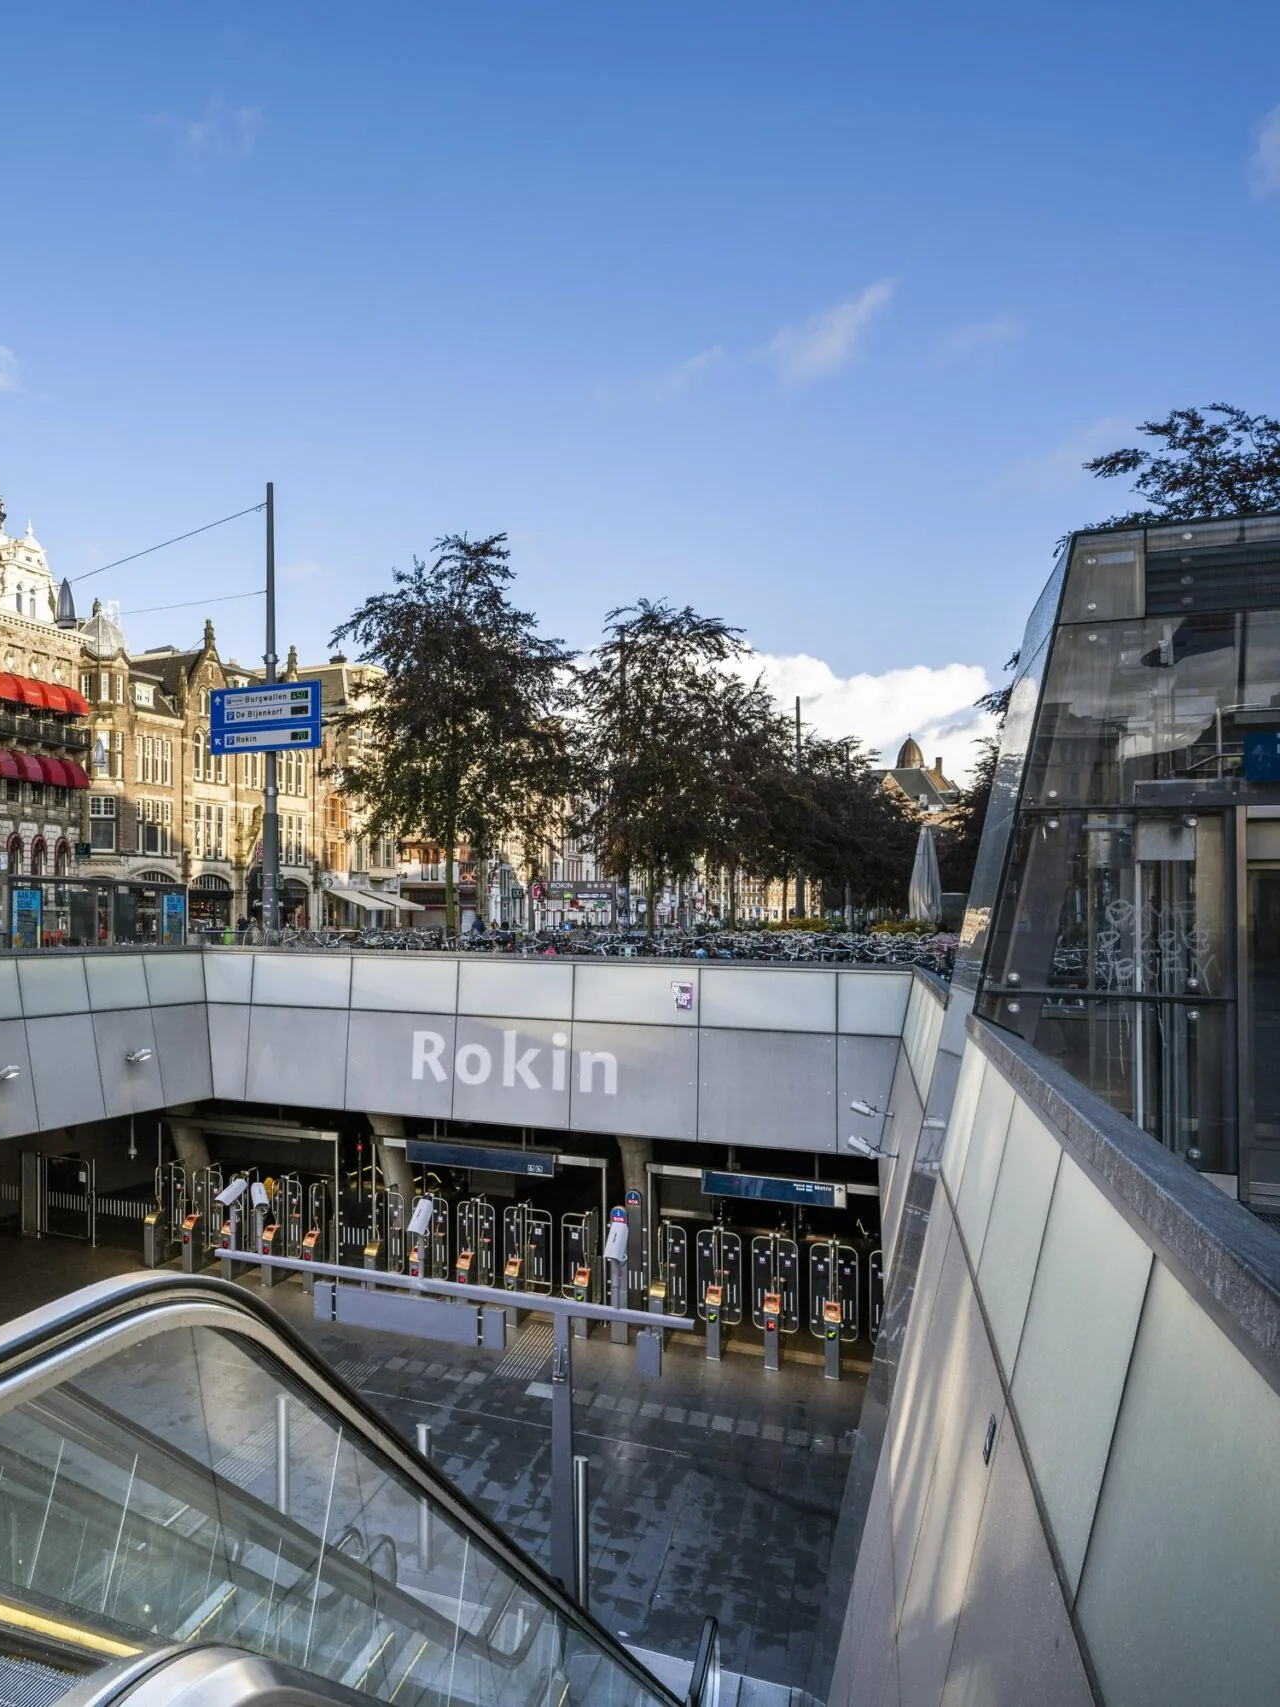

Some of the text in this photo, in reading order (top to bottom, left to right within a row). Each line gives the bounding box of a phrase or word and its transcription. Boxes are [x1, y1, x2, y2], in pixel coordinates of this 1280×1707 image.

[245, 694, 287, 704] Burgwallen
[236, 711, 245, 719] De
[248, 708, 283, 719] Bijenkorf
[411, 1030, 618, 1095] Rokin
